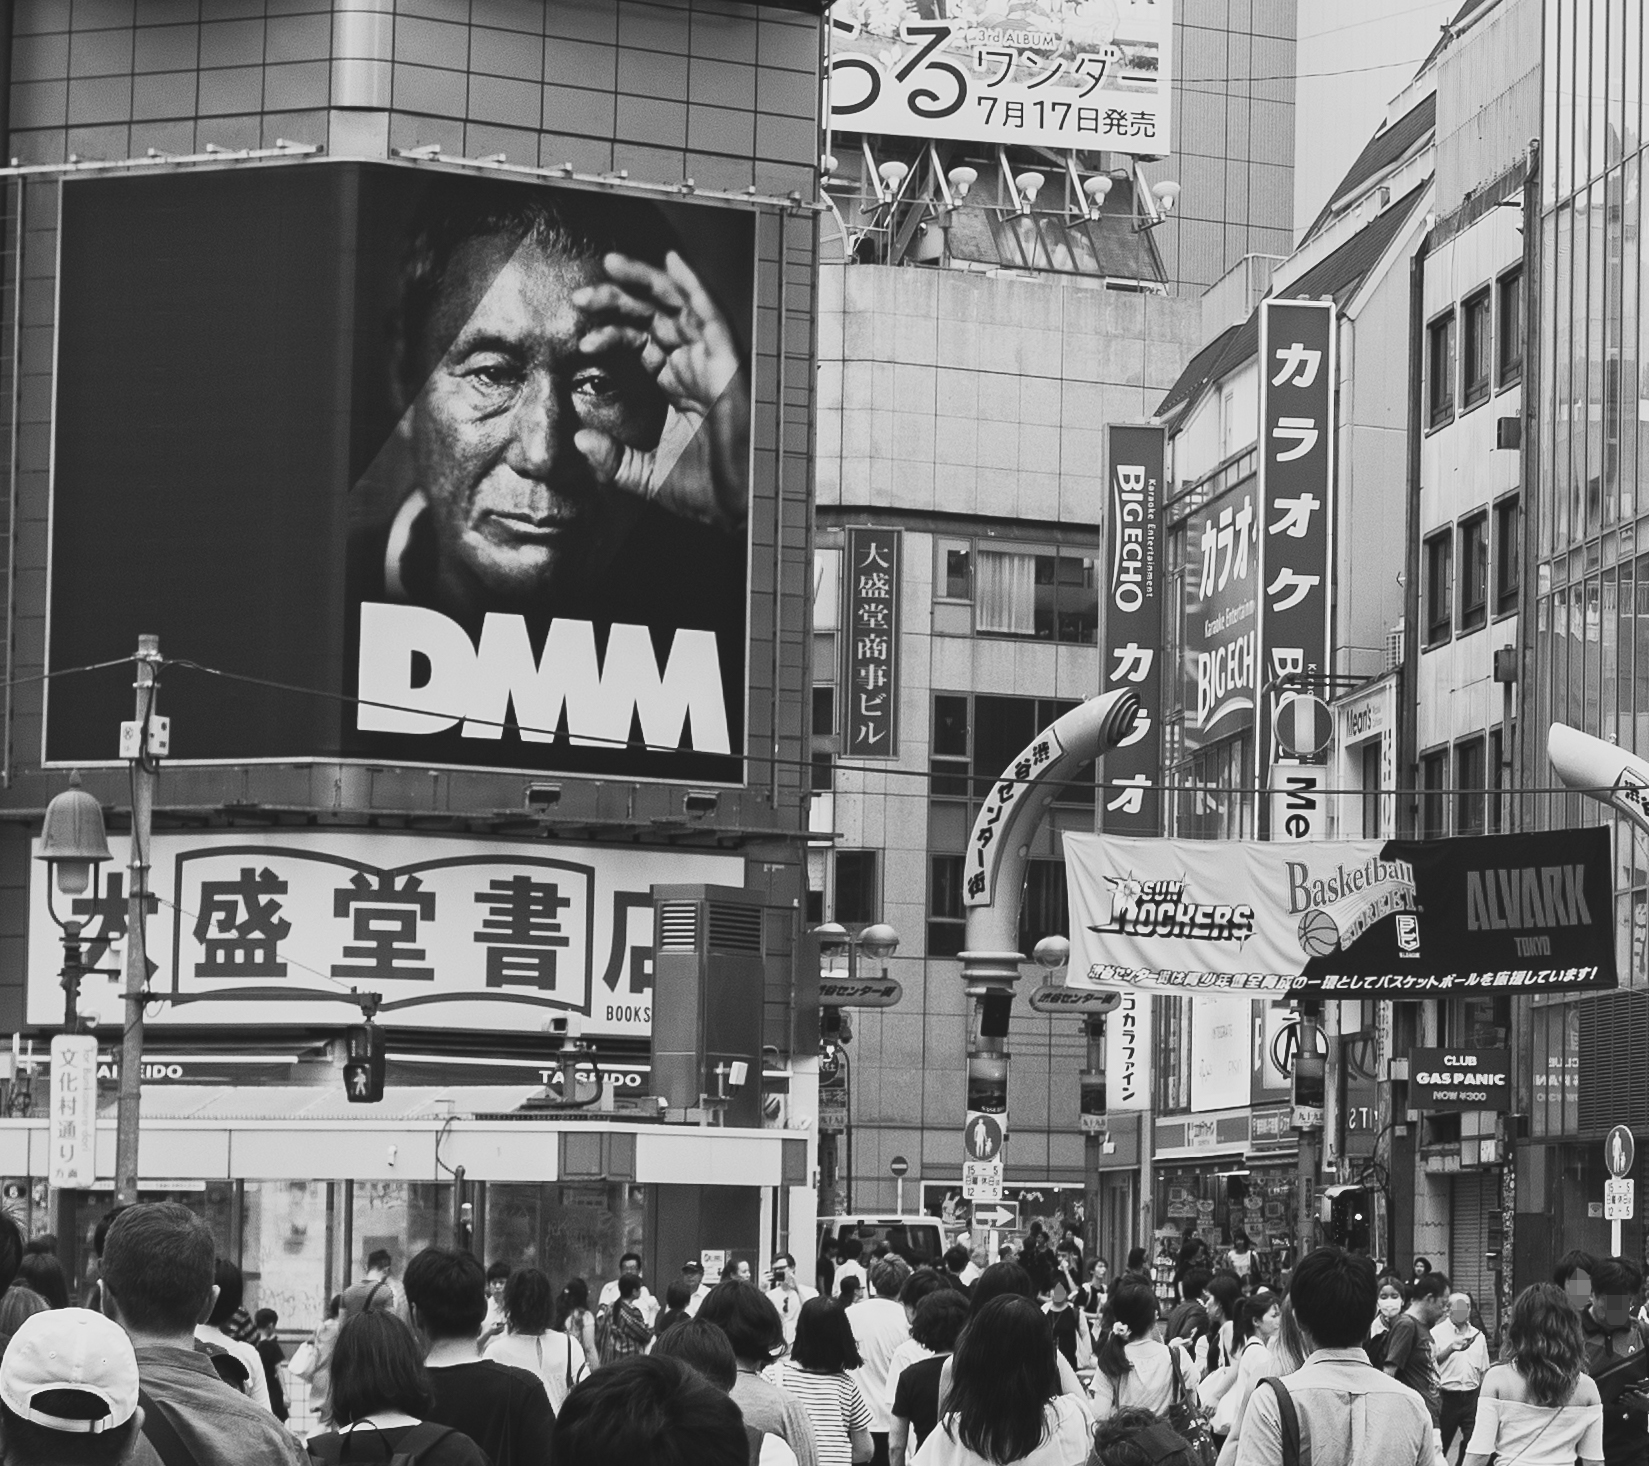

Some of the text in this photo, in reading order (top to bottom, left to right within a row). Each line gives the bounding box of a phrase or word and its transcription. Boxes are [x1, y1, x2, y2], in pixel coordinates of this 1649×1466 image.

[977, 27, 1055, 48] 3rd ALBUM
[977, 50, 1158, 101] ワンダー
[977, 95, 1157, 139] 7月17日発売
[1267, 342, 1322, 616] カラオケ
[1115, 465, 1145, 613] BIG ECHO
[1146, 478, 1157, 599] Karaoke Entertainment
[1199, 496, 1257, 601] カラオ
[855, 541, 890, 747] 大盛堂商事ビル
[357, 601, 732, 755] DMM
[1197, 648, 1224, 727] BIG
[1227, 631, 1255, 697] ECH
[967, 742, 1051, 897] 渋谷センター街
[1141, 880, 1184, 900] SUN
[1286, 857, 1416, 914] Basketball
[1467, 864, 1592, 930] ALVARK
[1340, 887, 1424, 950] STREET
[1514, 935, 1551, 958] TOKYO
[605, 1005, 651, 1023] BOOKS
[1416, 1072, 1506, 1086] GAS PANIC
[1443, 1054, 1478, 1066] CLUB
[58, 1048, 78, 1163] 文化村通り
[1433, 1091, 1487, 1101] NOW ¥300
